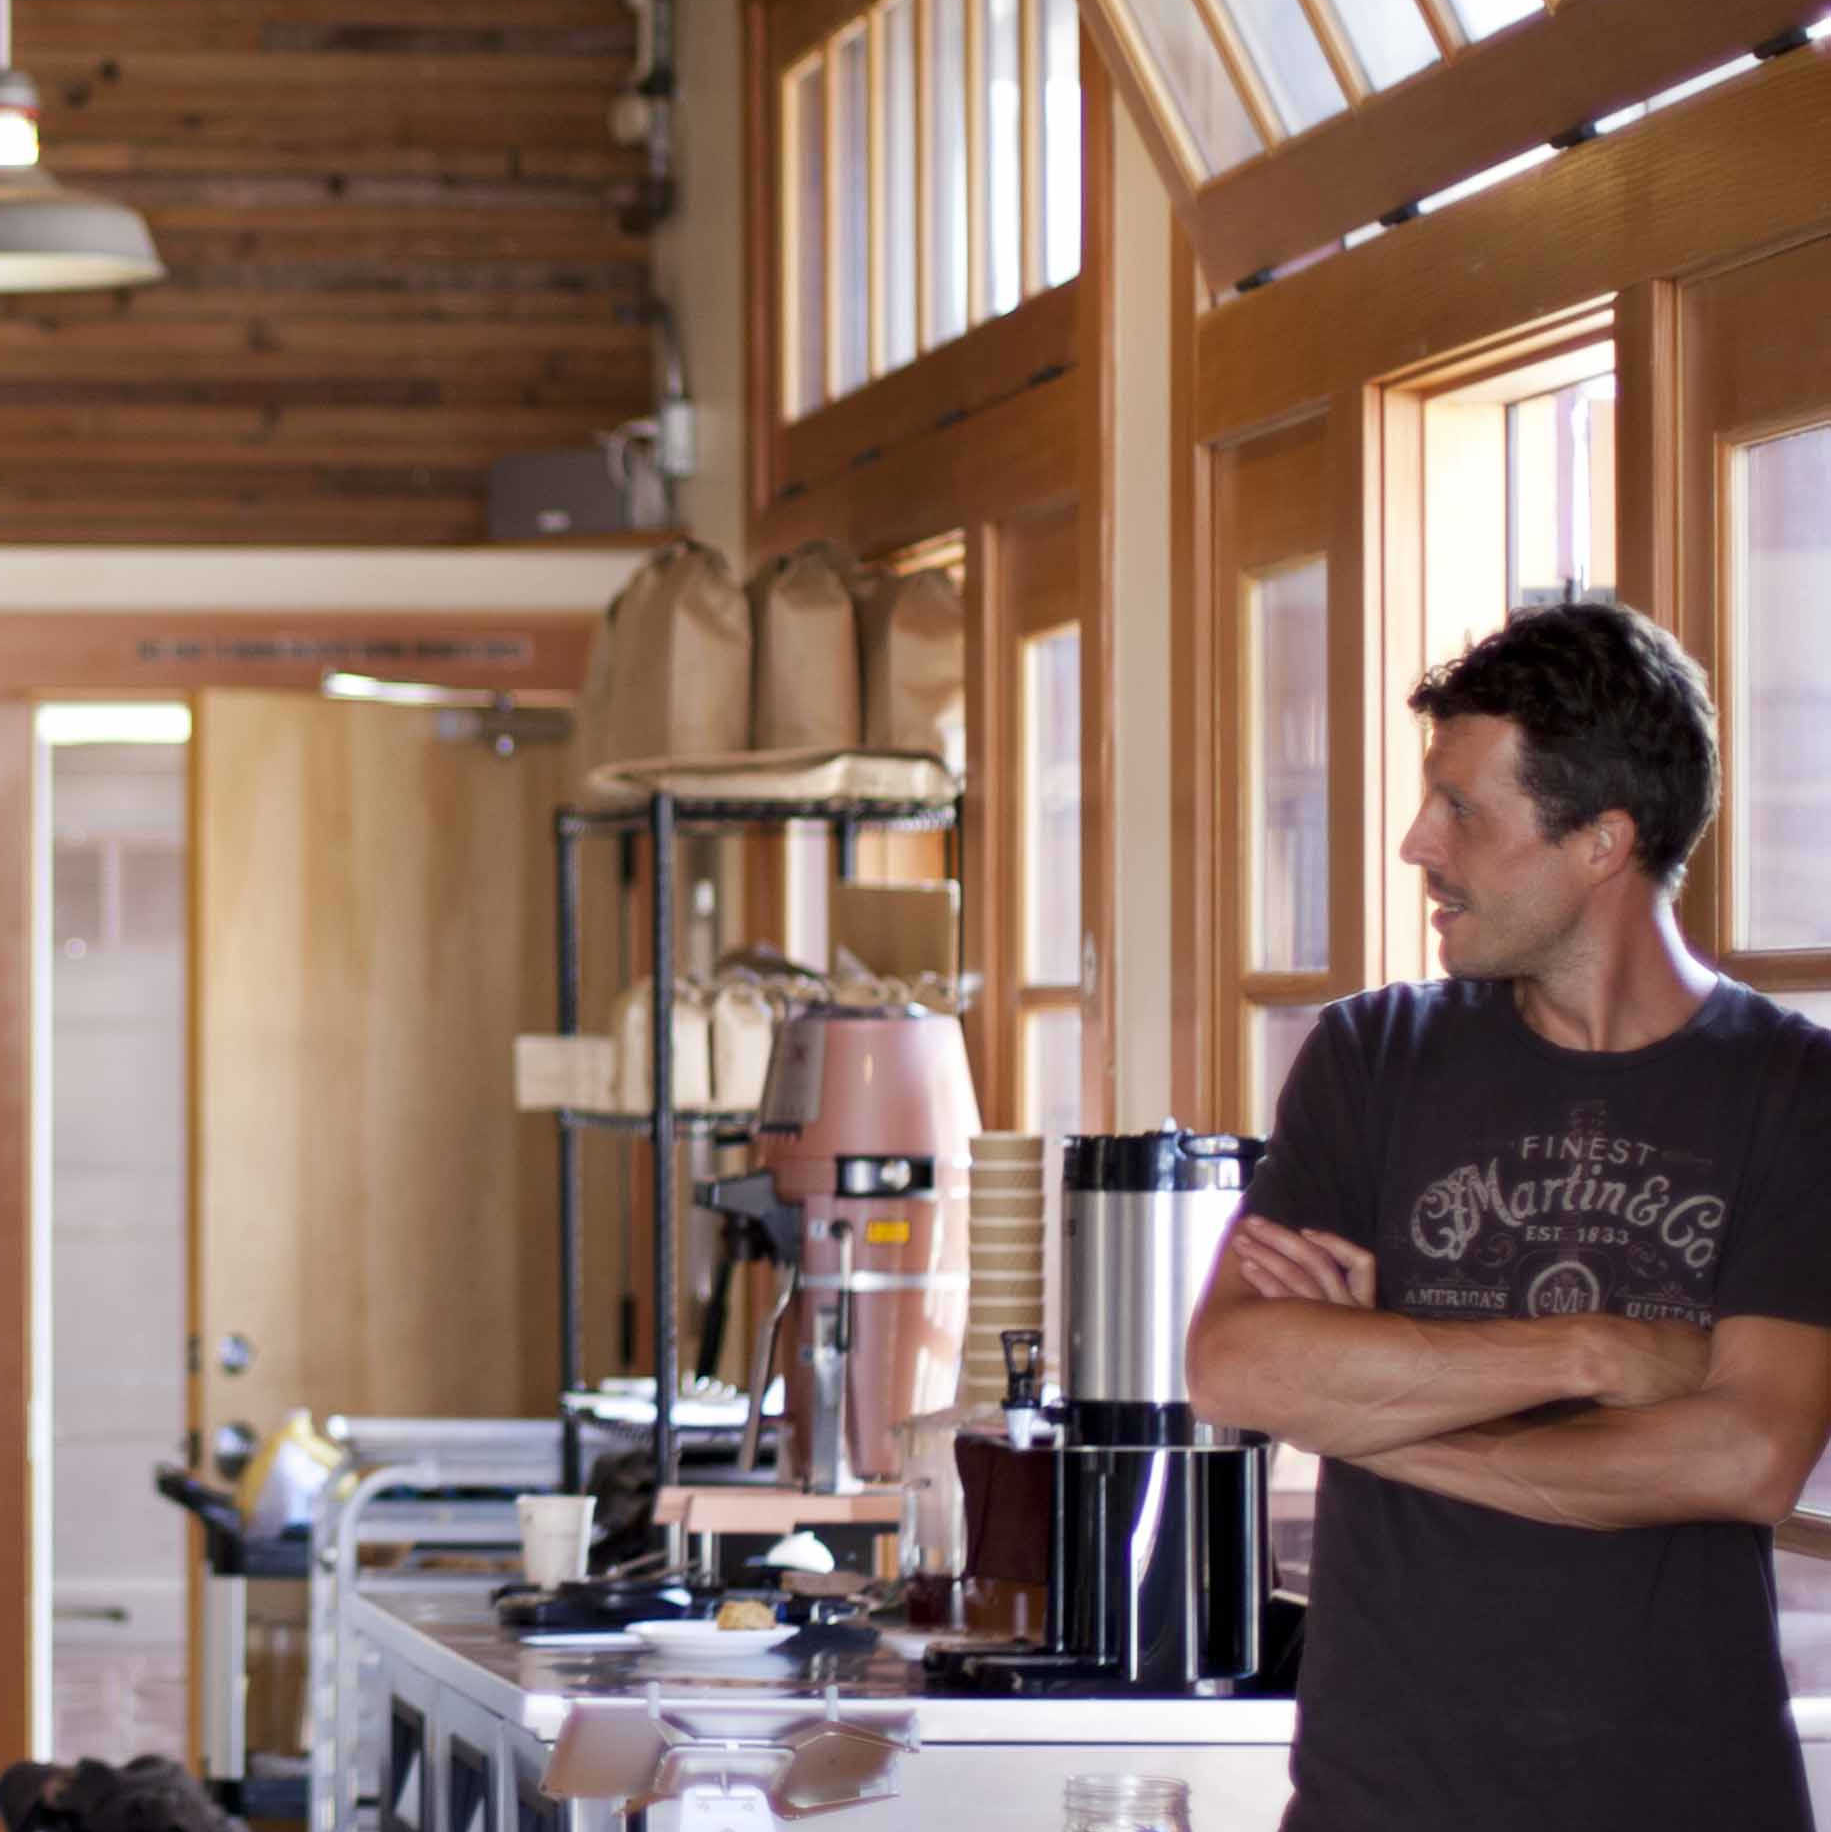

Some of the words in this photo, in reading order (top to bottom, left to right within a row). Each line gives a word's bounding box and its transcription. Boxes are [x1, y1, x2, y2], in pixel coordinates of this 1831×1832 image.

[1521, 1135, 1657, 1167] FINEST
[1524, 1224, 1562, 1243] EST
[1576, 1224, 1630, 1247] 1833
